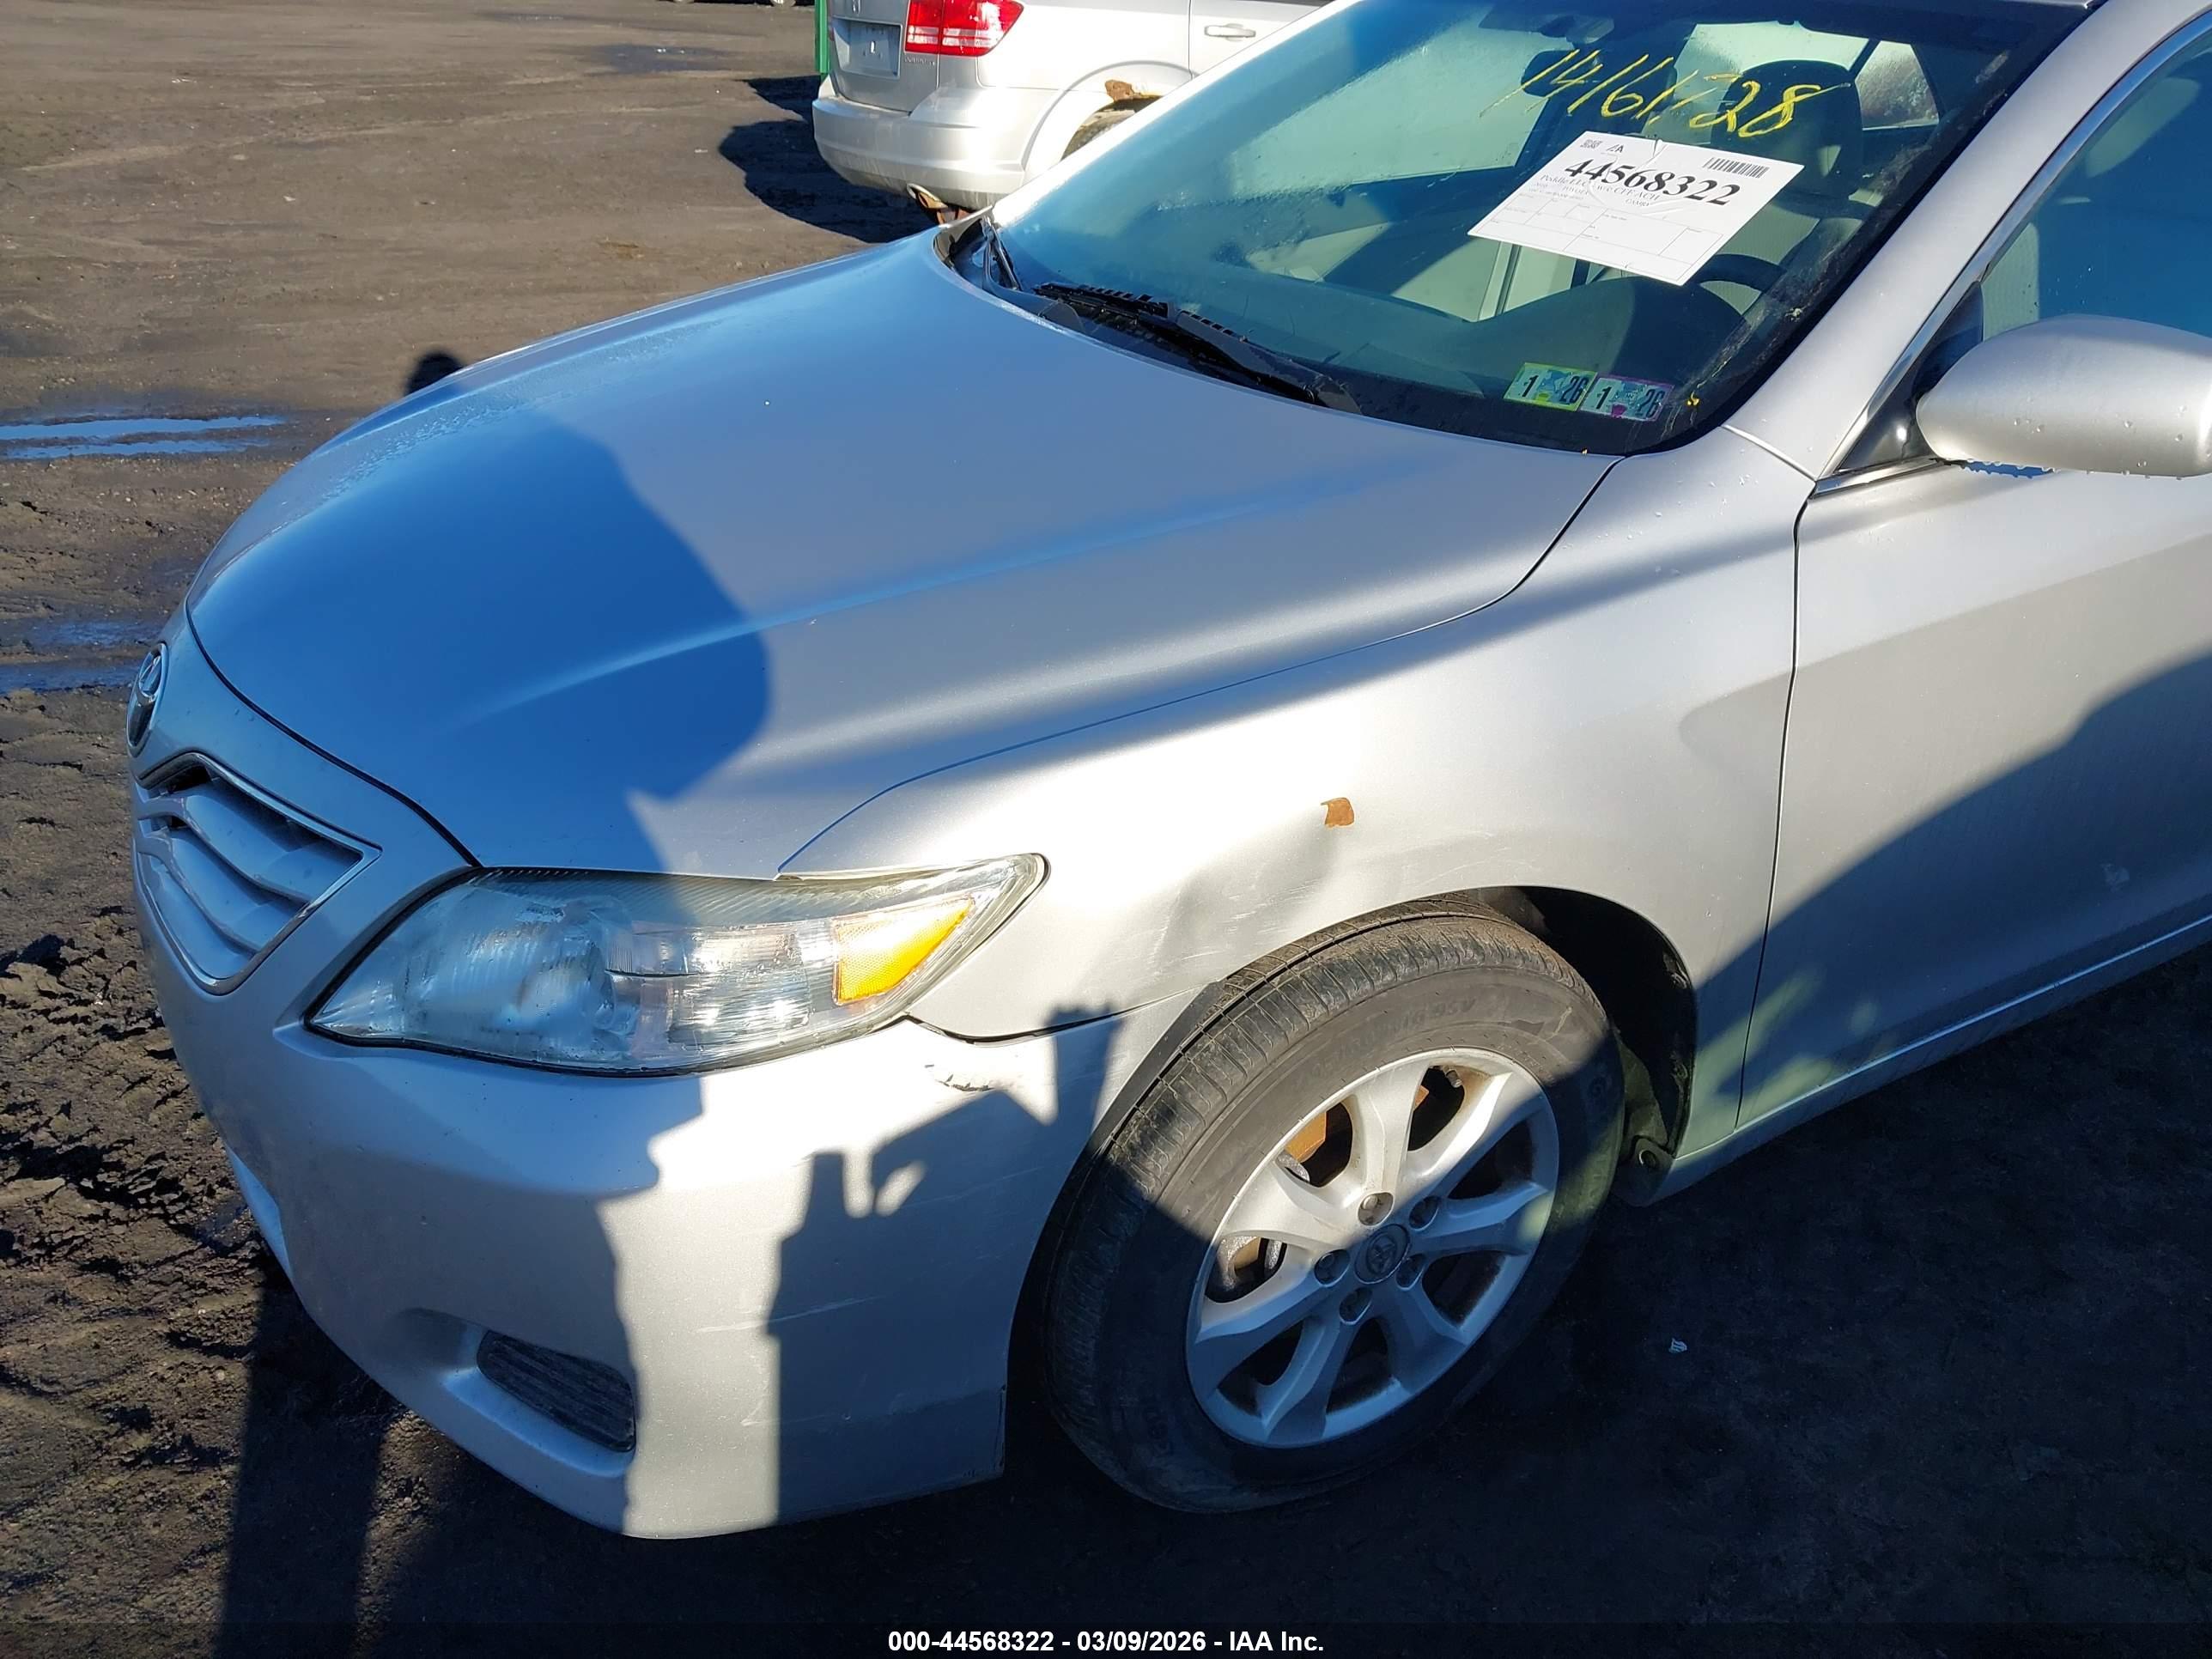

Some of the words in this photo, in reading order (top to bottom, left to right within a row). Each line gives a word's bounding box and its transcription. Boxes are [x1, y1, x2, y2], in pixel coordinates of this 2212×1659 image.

[1564, 157, 1741, 206] 44568322
[1522, 374, 1539, 398] 1
[1595, 386, 1613, 410] 1
